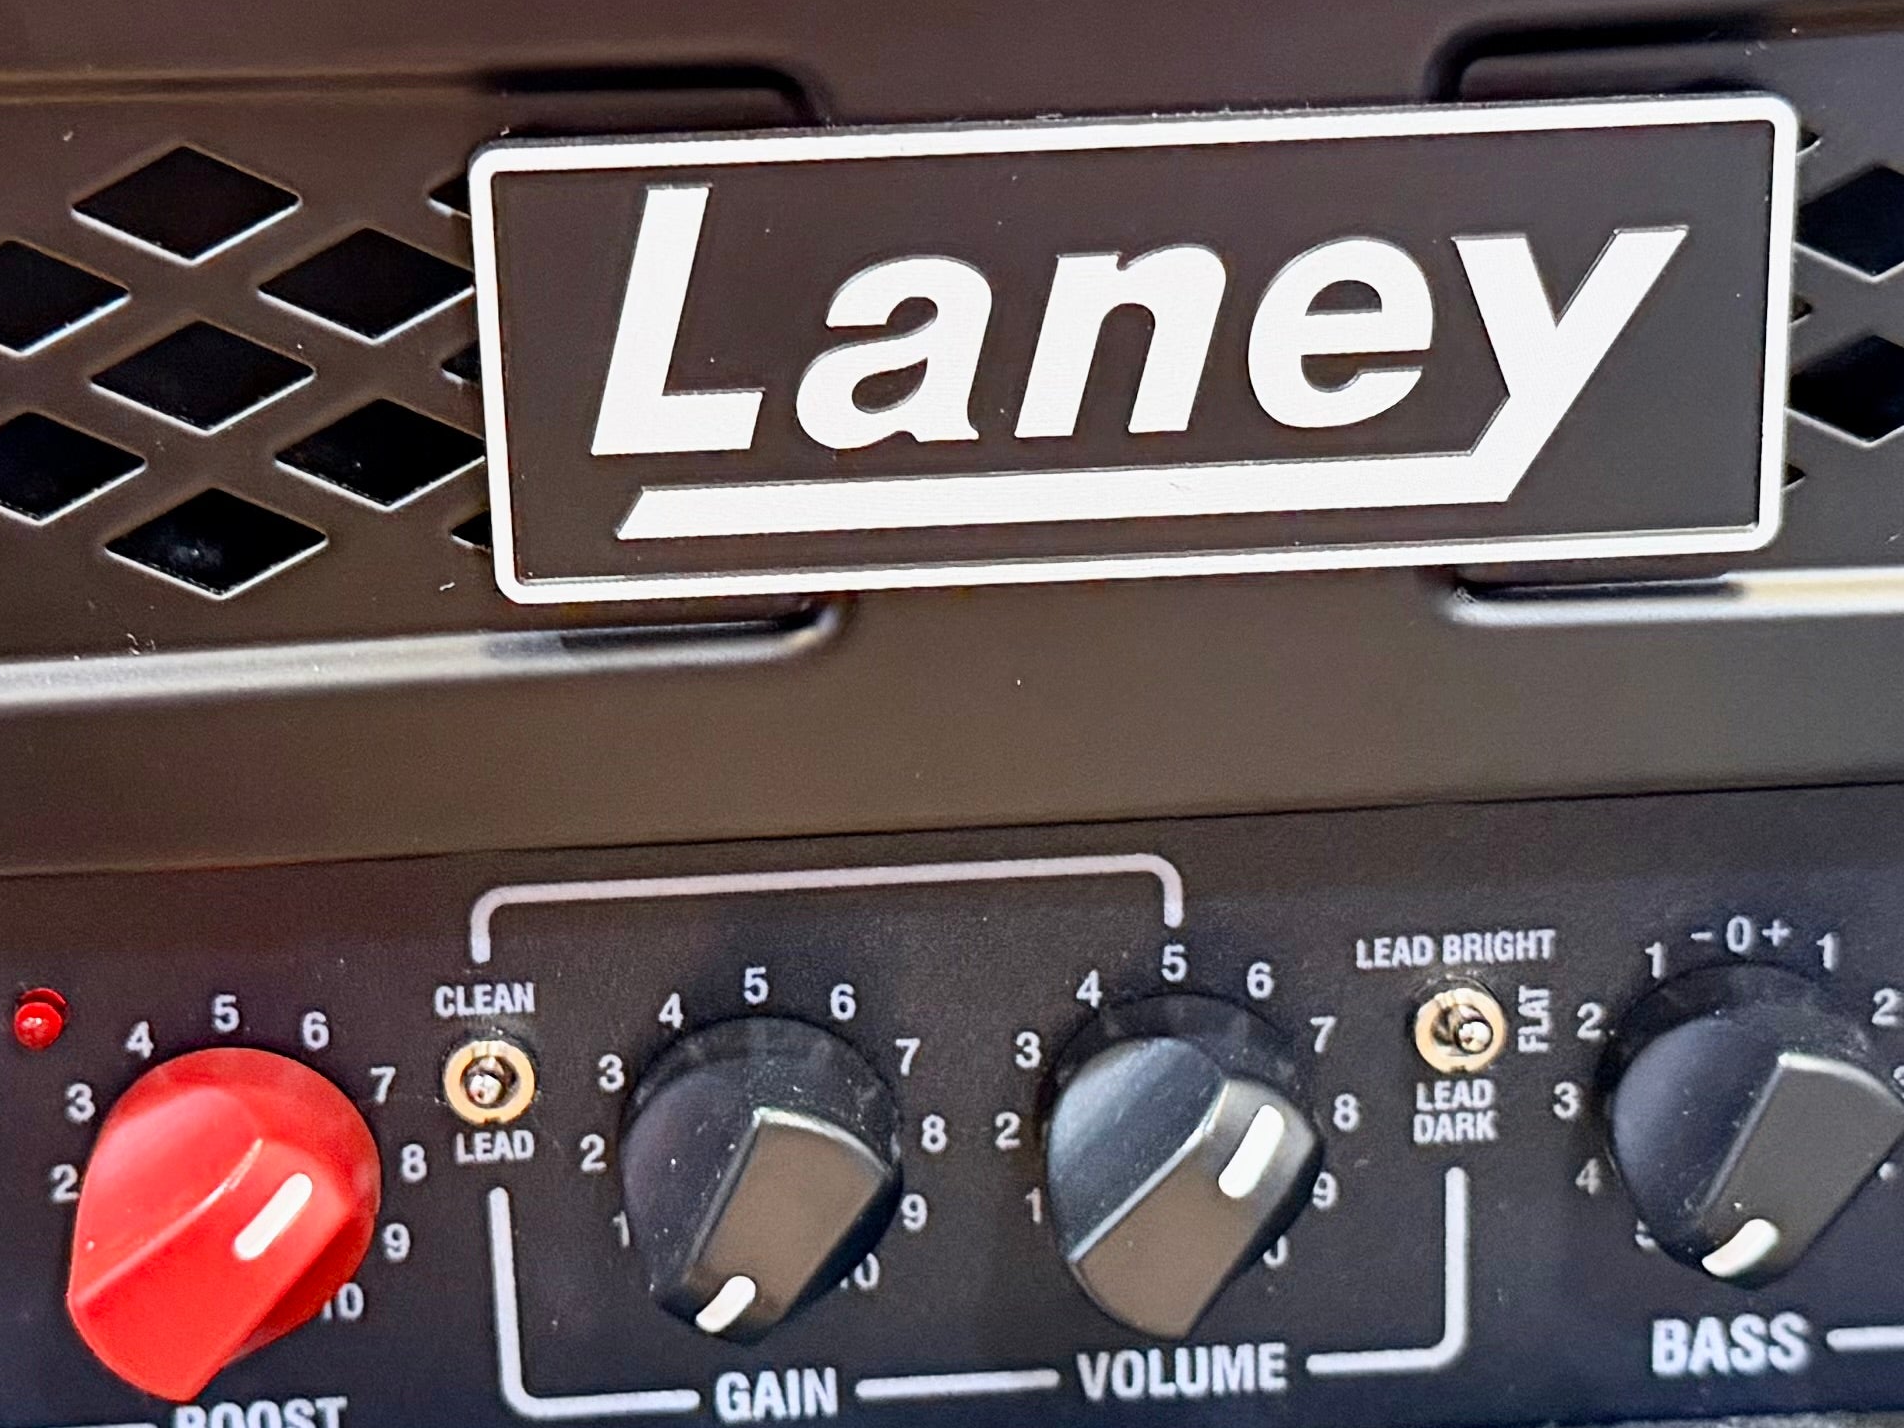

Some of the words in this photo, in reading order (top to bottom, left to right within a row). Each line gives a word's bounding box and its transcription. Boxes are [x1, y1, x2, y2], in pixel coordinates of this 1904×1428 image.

[591, 184, 1687, 539] Laney
[1161, 946, 1188, 982] 5
[1357, 936, 1434, 968] LEAD
[1443, 930, 1555, 963] BRIGHT
[1645, 942, 1665, 977] 1
[1817, 933, 1840, 967] 1
[743, 967, 768, 1004] 5
[1076, 972, 1102, 1008] 4
[1246, 962, 1273, 998] 6
[213, 995, 238, 1033] 5
[435, 983, 534, 1017] CLEAN
[657, 994, 684, 1029] 4
[830, 984, 856, 1021] 6
[1518, 984, 1550, 1052] FLAT
[1872, 988, 1900, 1024] 2
[302, 1013, 328, 1049] 6
[1311, 1017, 1336, 1052] 7
[1577, 1003, 1604, 1038] 2
[126, 1021, 153, 1059] 4
[896, 1039, 919, 1076] 7
[1015, 1032, 1042, 1068] 3
[370, 1066, 396, 1103] 7
[598, 1054, 625, 1091] 3
[66, 1085, 95, 1121] 3
[1333, 1095, 1359, 1130] 8
[1415, 1081, 1494, 1111] LEAD
[1554, 1084, 1578, 1117] 3
[921, 1114, 947, 1150] 8
[994, 1113, 1020, 1148] 2
[1413, 1113, 1496, 1143] DARK
[401, 1143, 427, 1180] 8
[455, 1130, 534, 1163] LEAD
[579, 1135, 606, 1172] 2
[51, 1165, 77, 1202] 2
[1312, 1173, 1338, 1209] 9
[1576, 1160, 1602, 1192] 4
[902, 1195, 928, 1230] 9
[1025, 1189, 1044, 1223] 1
[383, 1223, 410, 1262] 9
[613, 1212, 631, 1246] 1
[1652, 1314, 1810, 1376] BASS
[1077, 1343, 1287, 1398] VOLUME
[715, 1367, 839, 1420] GAIN
